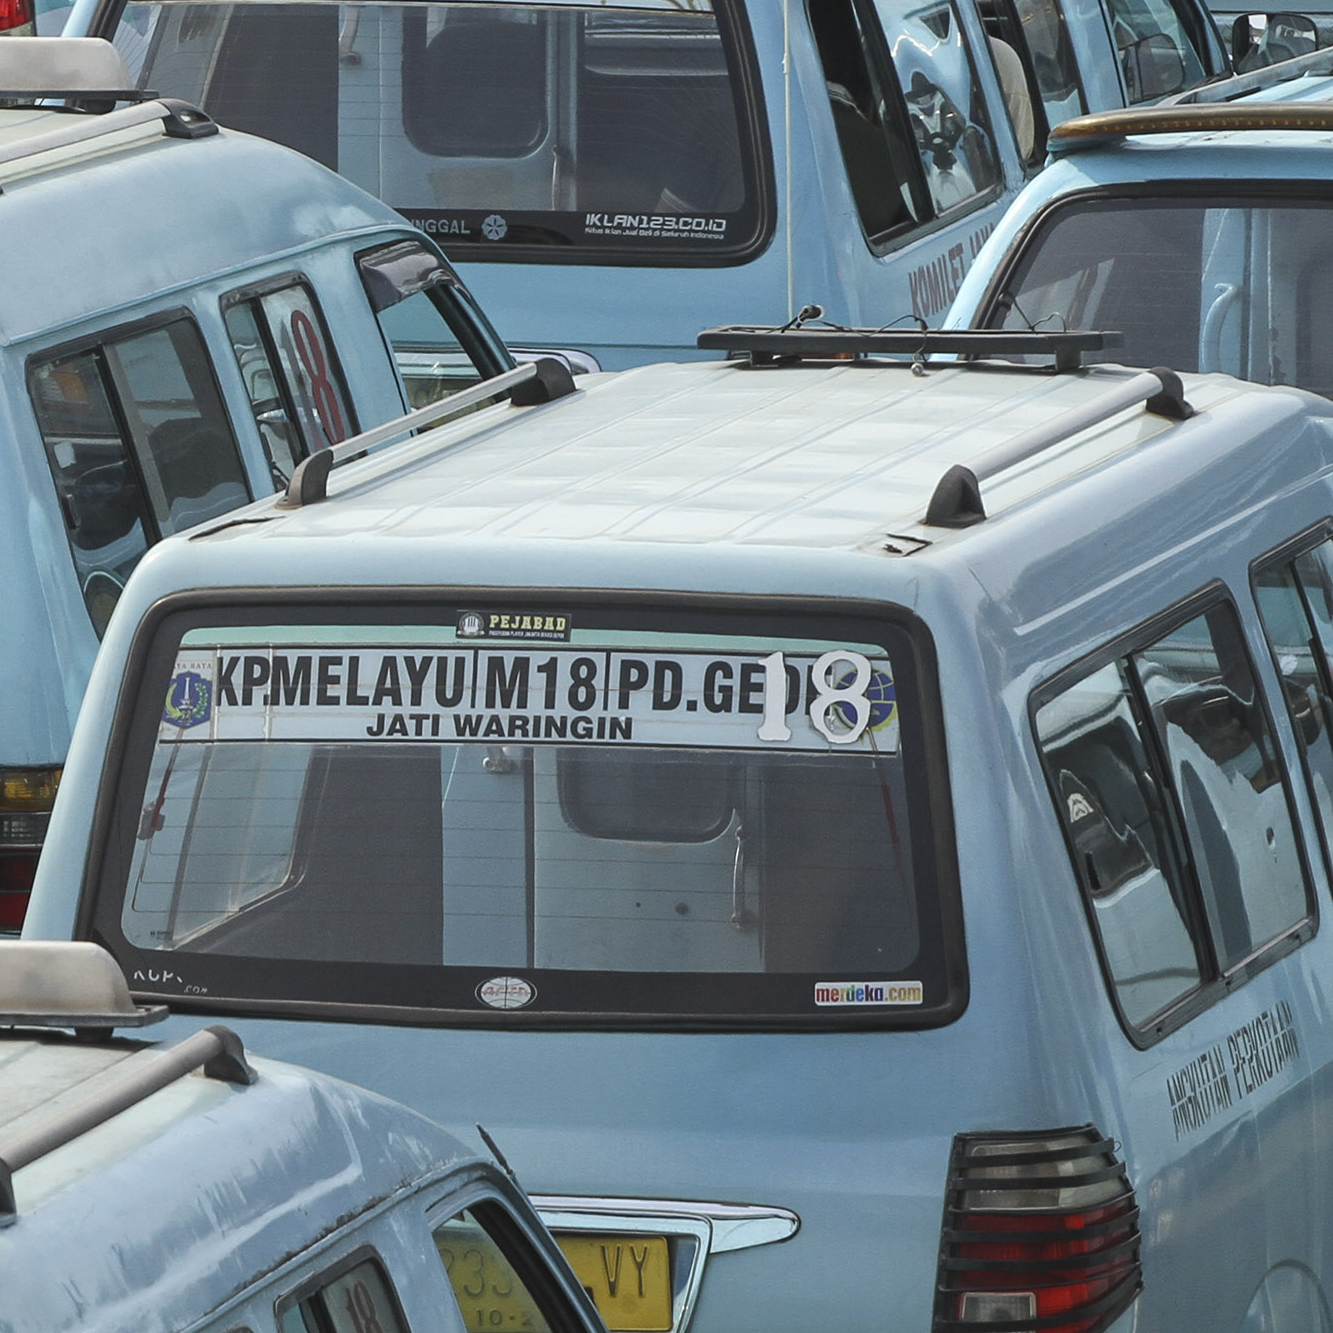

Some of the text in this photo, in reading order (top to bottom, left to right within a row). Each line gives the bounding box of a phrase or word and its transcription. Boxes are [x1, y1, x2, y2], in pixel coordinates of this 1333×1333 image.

[585, 213, 726, 231] IKLAN123.CO.ID
[489, 614, 566, 631] PEJABAD
[480, 656, 597, 711] M18
[756, 649, 873, 745] 18
[366, 714, 633, 740] JATI WARINGIN
[816, 985, 921, 1002] merdeka.com
[600, 1243, 650, 1297] VY
